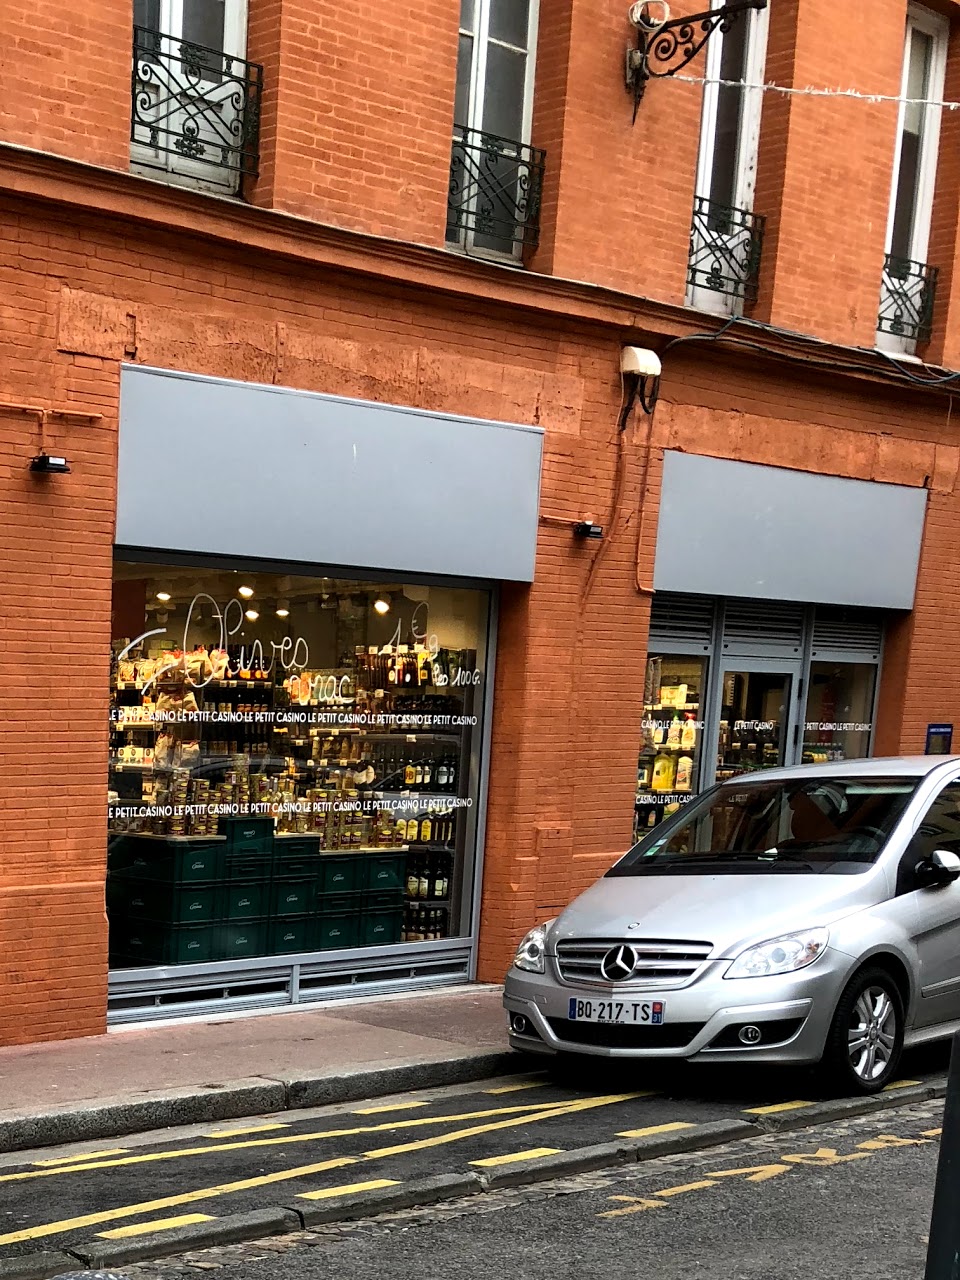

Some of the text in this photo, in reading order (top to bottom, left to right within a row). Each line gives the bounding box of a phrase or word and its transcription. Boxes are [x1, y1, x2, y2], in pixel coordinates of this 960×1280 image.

[183, 592, 309, 688] Olives
[178, 711, 187, 722] LE
[189, 711, 210, 722] PETIT
[211, 711, 243, 723] CASINO
[244, 712, 252, 723] LE
[255, 712, 275, 723] PETIT
[276, 712, 306, 723] CASINO
[308, 713, 316, 723] LE
[318, 713, 337, 723] PETIT
[338, 713, 366, 724] CASINO
[368, 714, 376, 724] LE
[377, 714, 396, 724] PETIT
[396, 714, 423, 725] CASINO
[424, 715, 432, 724] LE
[433, 715, 451, 725] PETIT
[452, 715, 477, 726] CASINO
[115, 807, 137, 818] PETIT
[140, 805, 172, 817] CASINO
[174, 805, 183, 816] LE
[185, 804, 206, 816] PETIT
[208, 803, 239, 815] CASINO
[241, 803, 249, 814] LE
[251, 802, 271, 813] PETIT
[271, 802, 301, 813] CASINO
[303, 802, 312, 813] LE
[313, 802, 332, 813] PETIT
[333, 800, 361, 812] CASINO
[363, 800, 372, 811] LE
[373, 800, 390, 811] PETIT
[392, 799, 418, 810] CASINO
[420, 799, 428, 809] LE
[429, 798, 446, 809] PETIT
[447, 798, 473, 808] CASINO
[652, 1013, 661, 1022] 31
